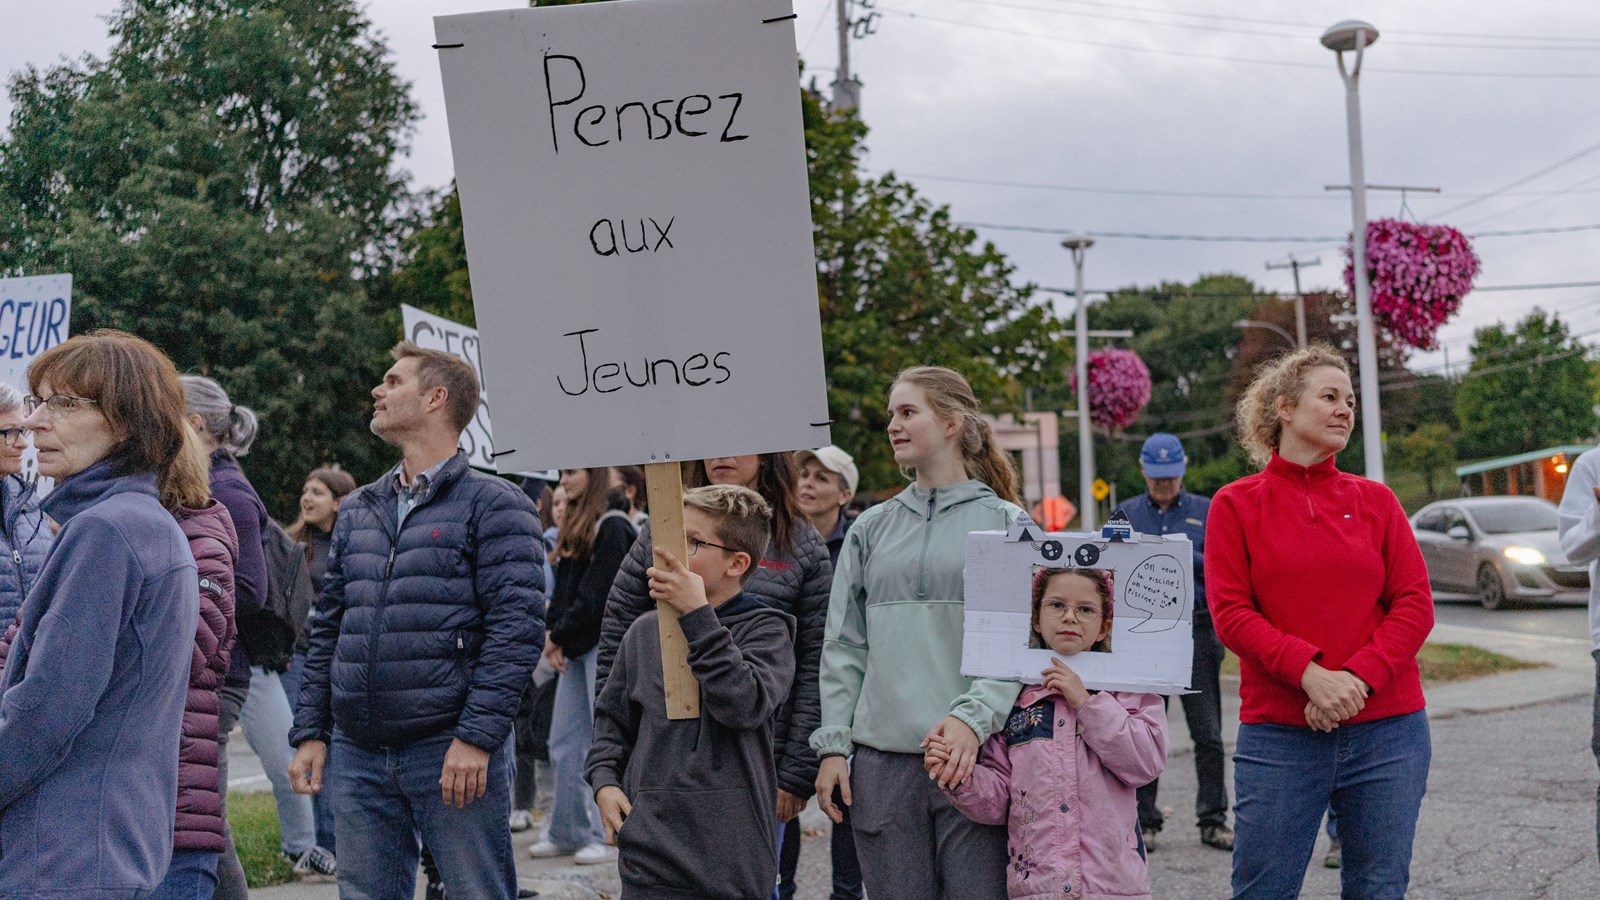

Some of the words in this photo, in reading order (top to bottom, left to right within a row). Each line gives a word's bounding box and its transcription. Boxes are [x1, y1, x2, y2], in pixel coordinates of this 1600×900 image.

[543, 55, 749, 154] Pensez
[590, 216, 675, 257] aux
[557, 328, 731, 396] Jeunes
[1143, 585, 1161, 594] veut
